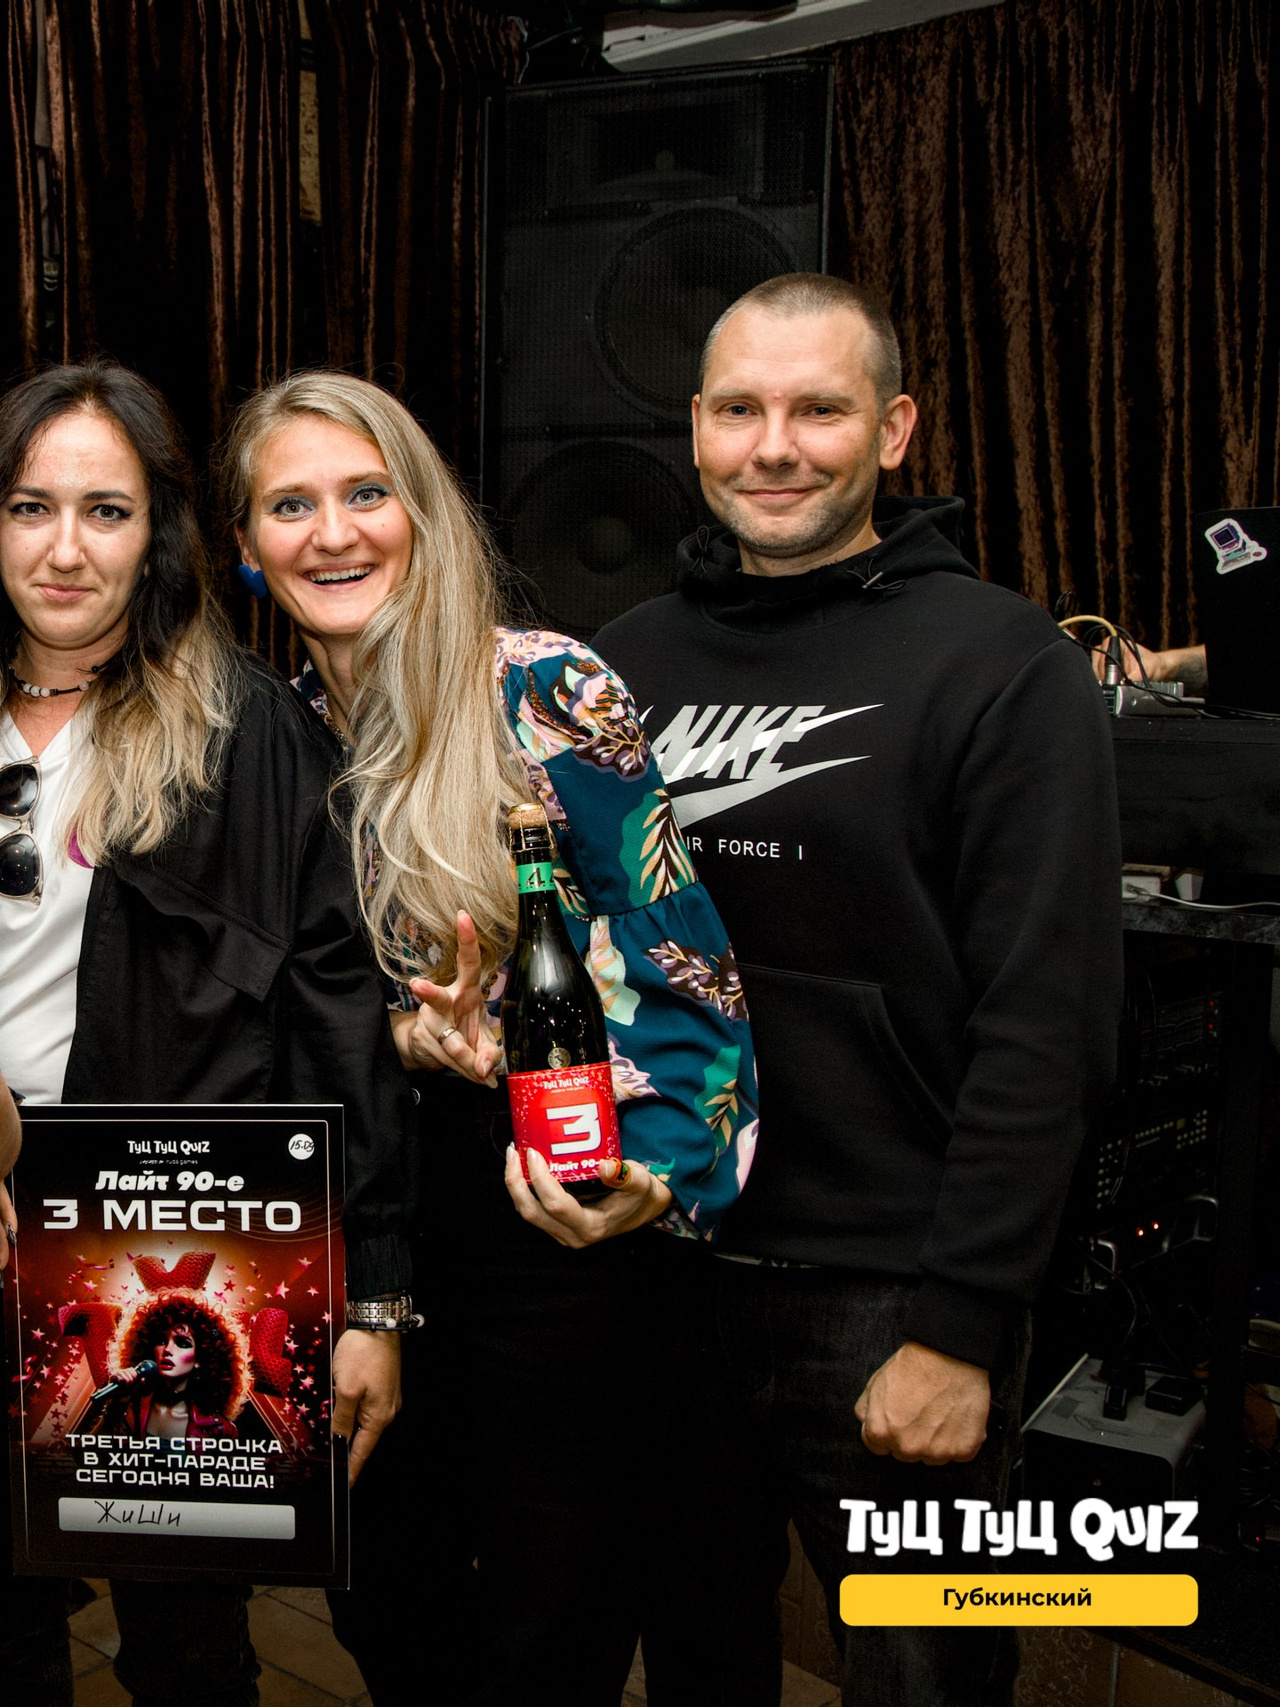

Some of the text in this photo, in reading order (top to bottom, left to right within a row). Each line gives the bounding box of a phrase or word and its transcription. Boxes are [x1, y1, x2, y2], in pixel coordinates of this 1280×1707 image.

[651, 705, 826, 780] NIKE
[686, 836, 703, 852] IR
[718, 839, 780, 858] FORCE
[546, 1102, 602, 1156] 3
[549, 1158, 604, 1172] Лайт 90-
[95, 1170, 245, 1191] Лайт 90-е
[43, 1199, 302, 1232] 3 МЕСТО
[66, 1434, 283, 1454] ТРЕТЬЯ СТРОЧКА
[83, 1452, 266, 1471] В ХИТ-ПАРАДЕ
[76, 1470, 274, 1489] СЕГОДНЯ ВАША!
